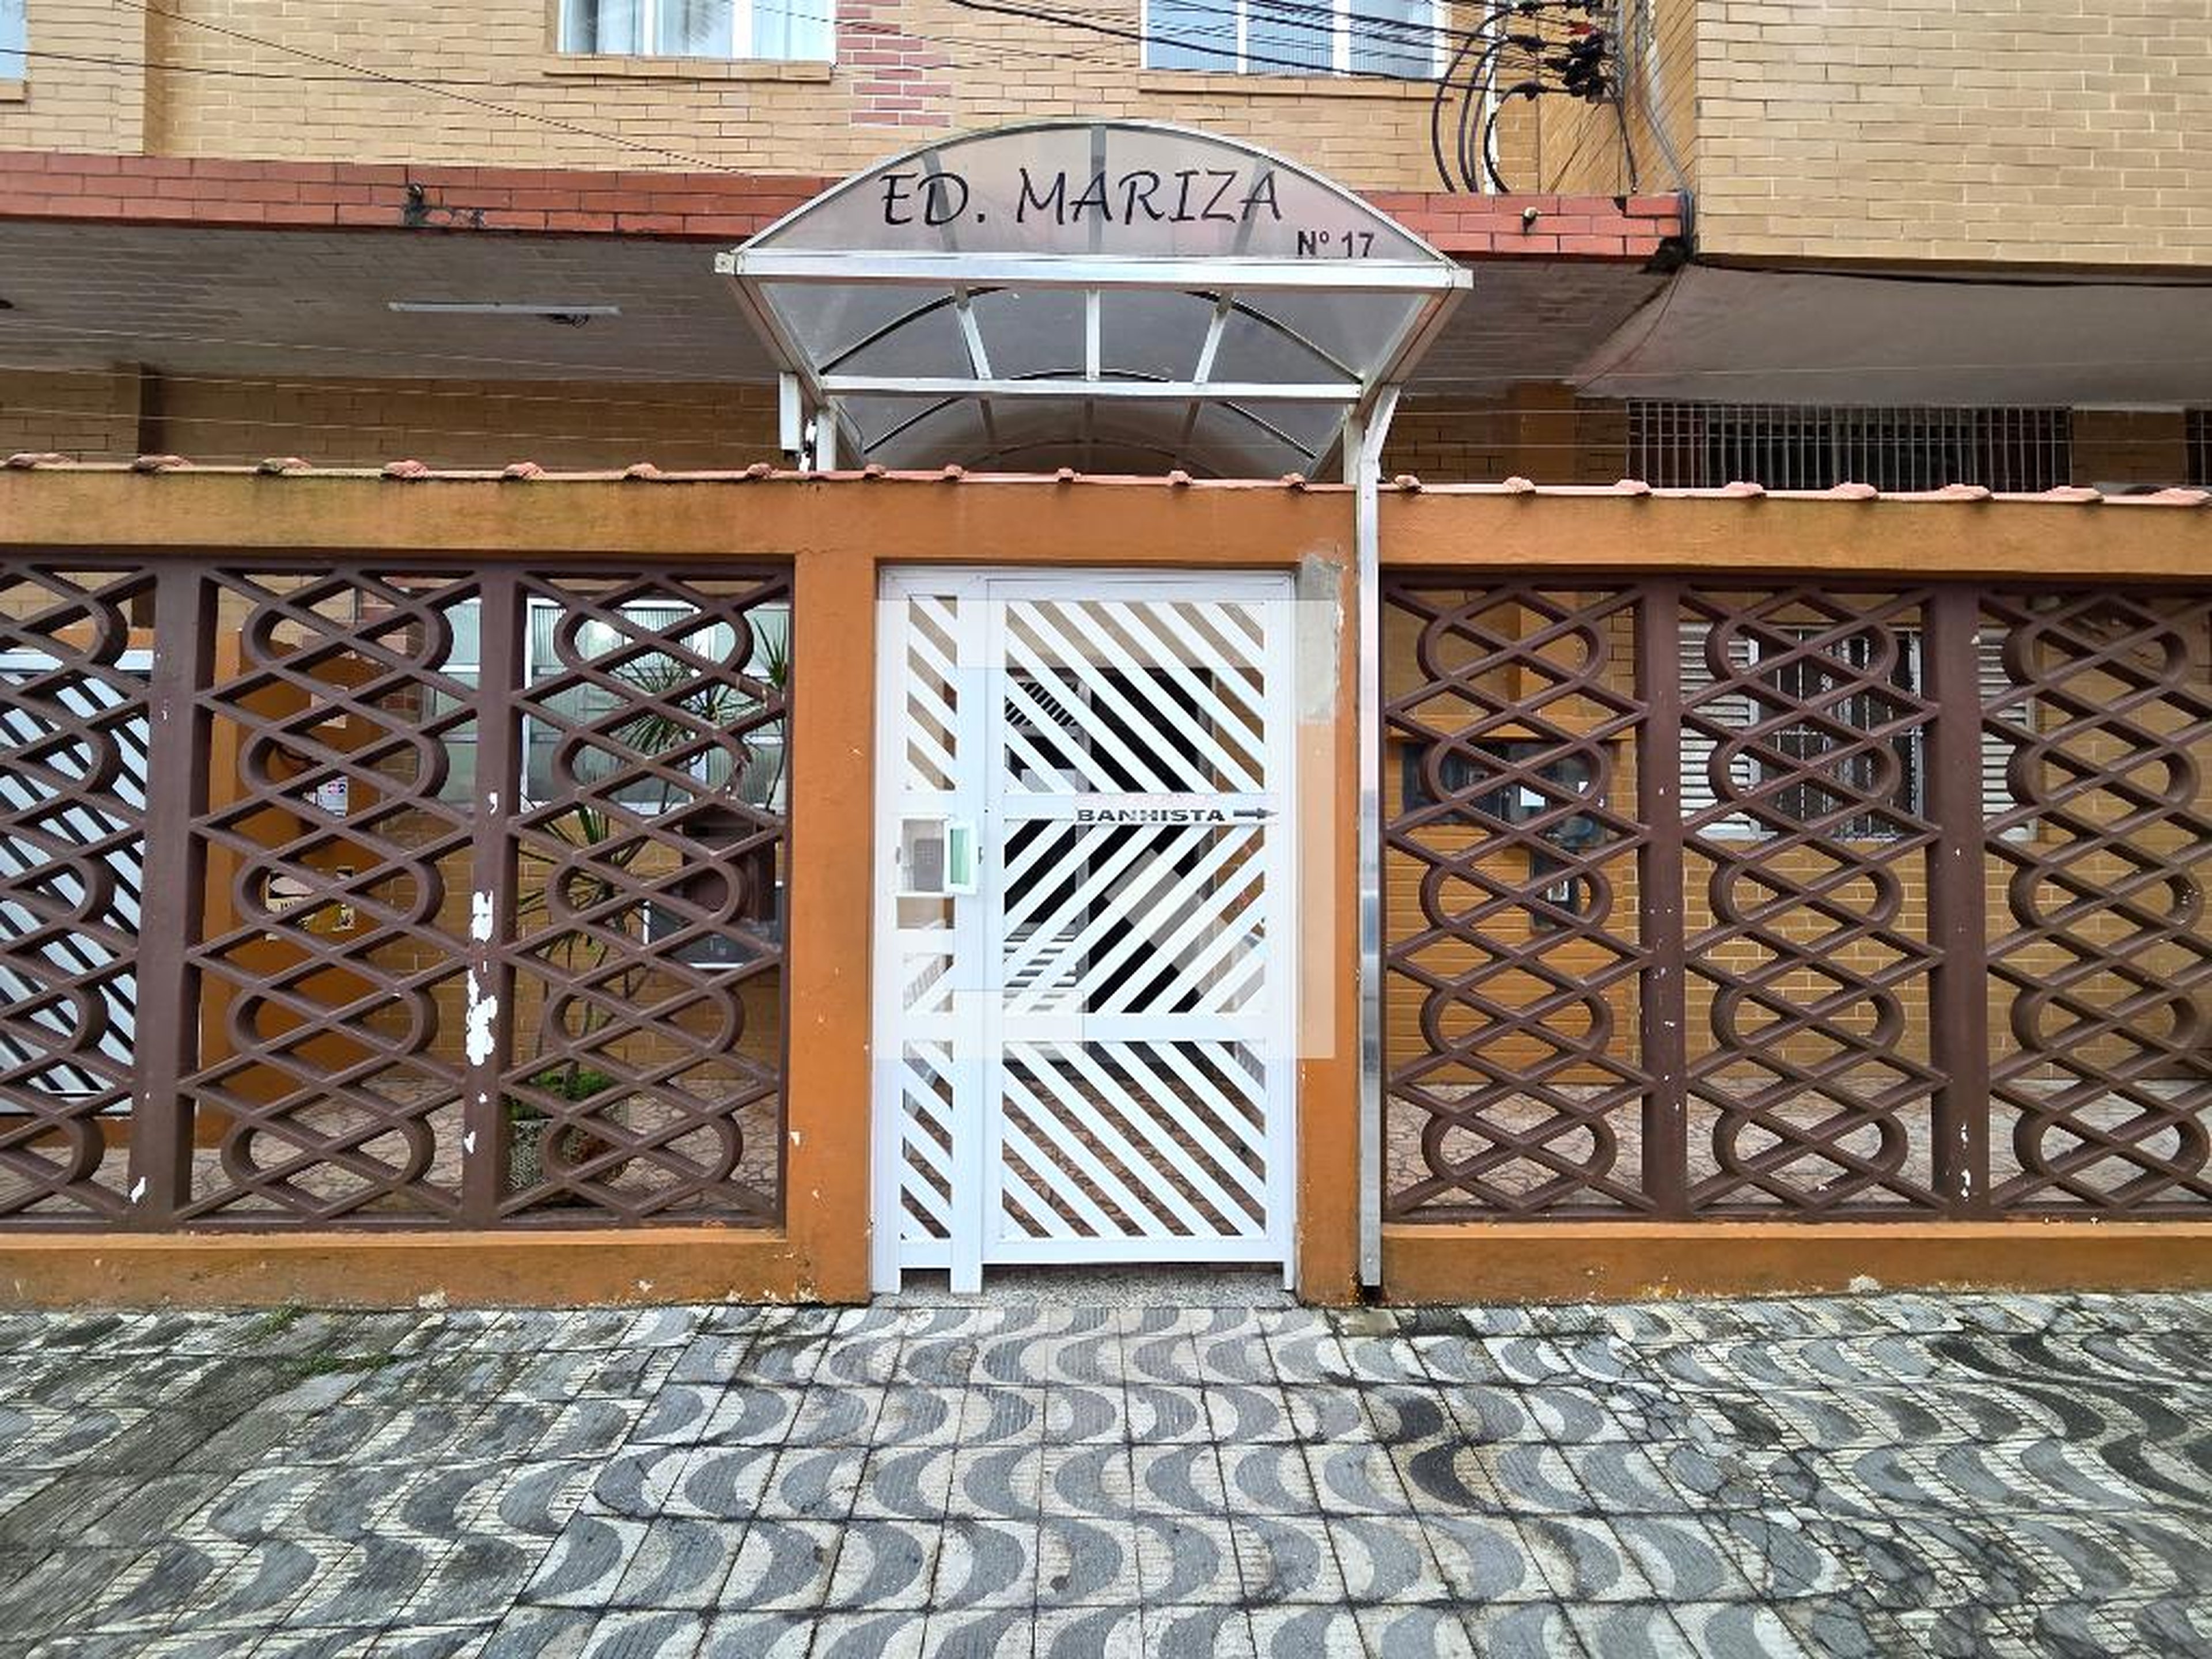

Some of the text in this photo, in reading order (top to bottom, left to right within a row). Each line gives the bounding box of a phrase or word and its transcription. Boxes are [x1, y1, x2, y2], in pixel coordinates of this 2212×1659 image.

[879, 167, 1282, 225] ED. MARIZA
[1342, 232, 1375, 257] 17
[1076, 808, 1226, 823] BANHISTA
